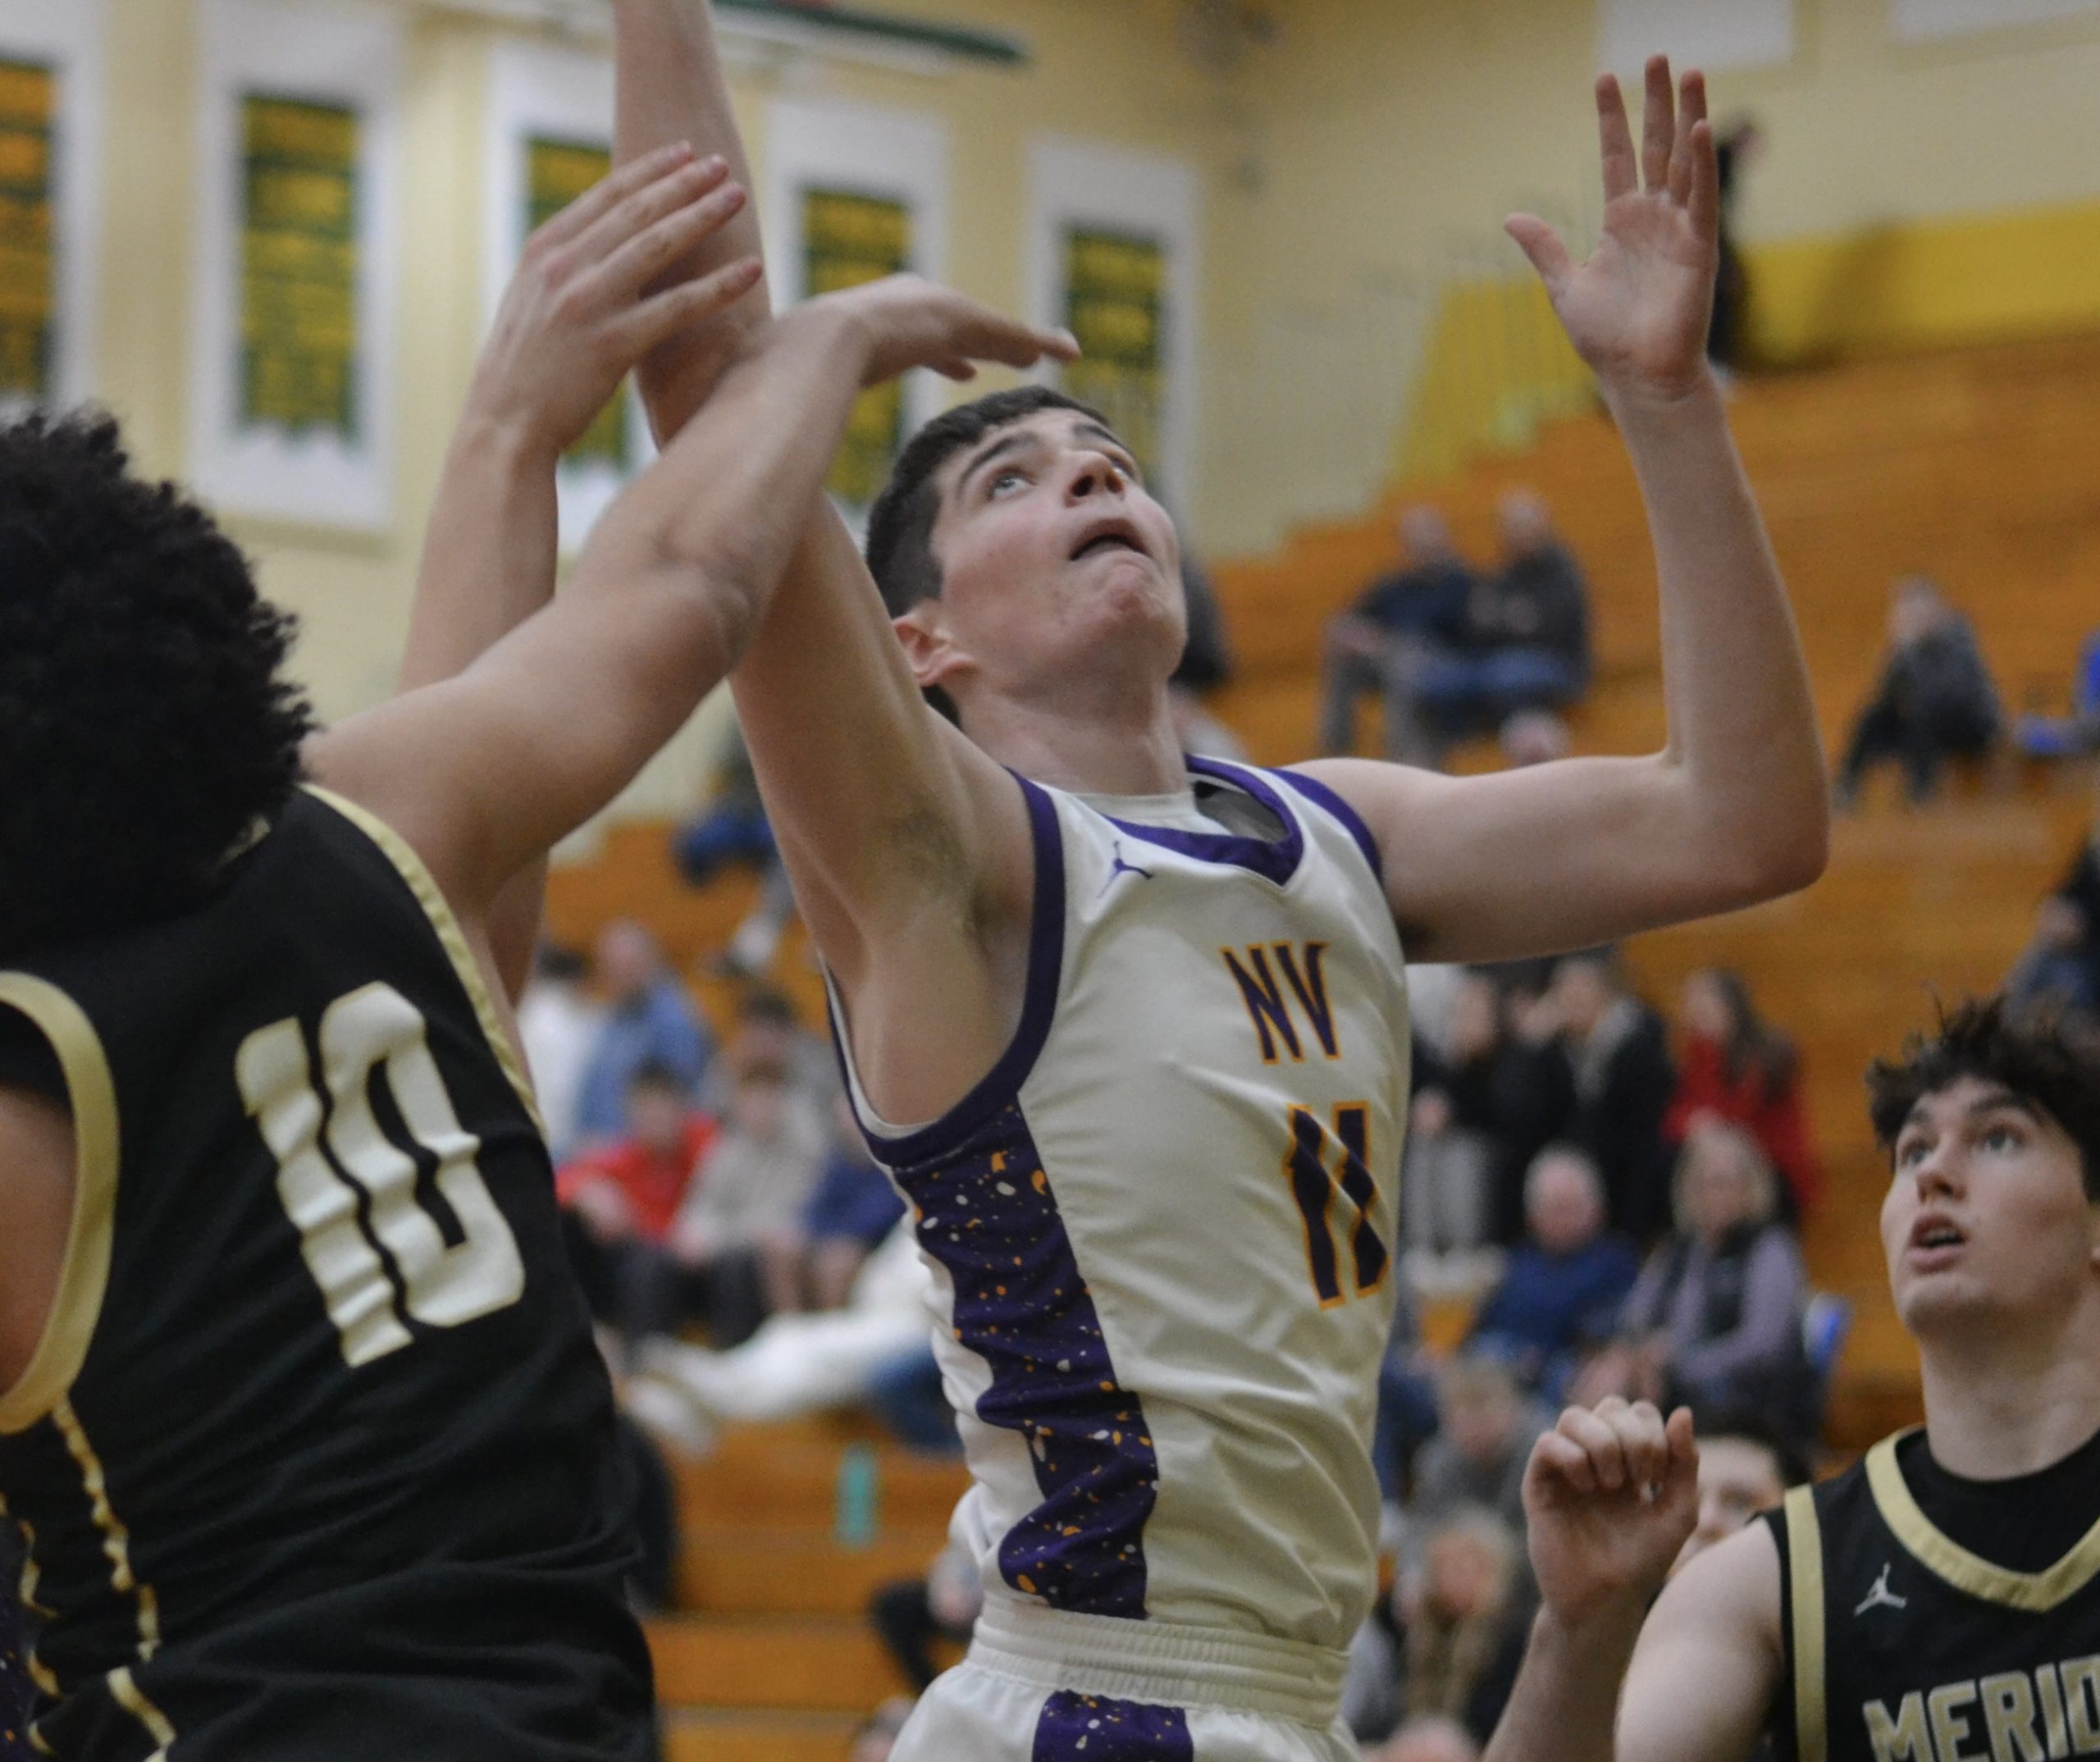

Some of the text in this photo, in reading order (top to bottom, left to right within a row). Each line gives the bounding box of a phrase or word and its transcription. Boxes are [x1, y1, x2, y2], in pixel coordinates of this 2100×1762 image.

[1220, 940, 1341, 1066] NV
[235, 980, 525, 1368] 10
[1283, 1099, 1391, 1311] 11
